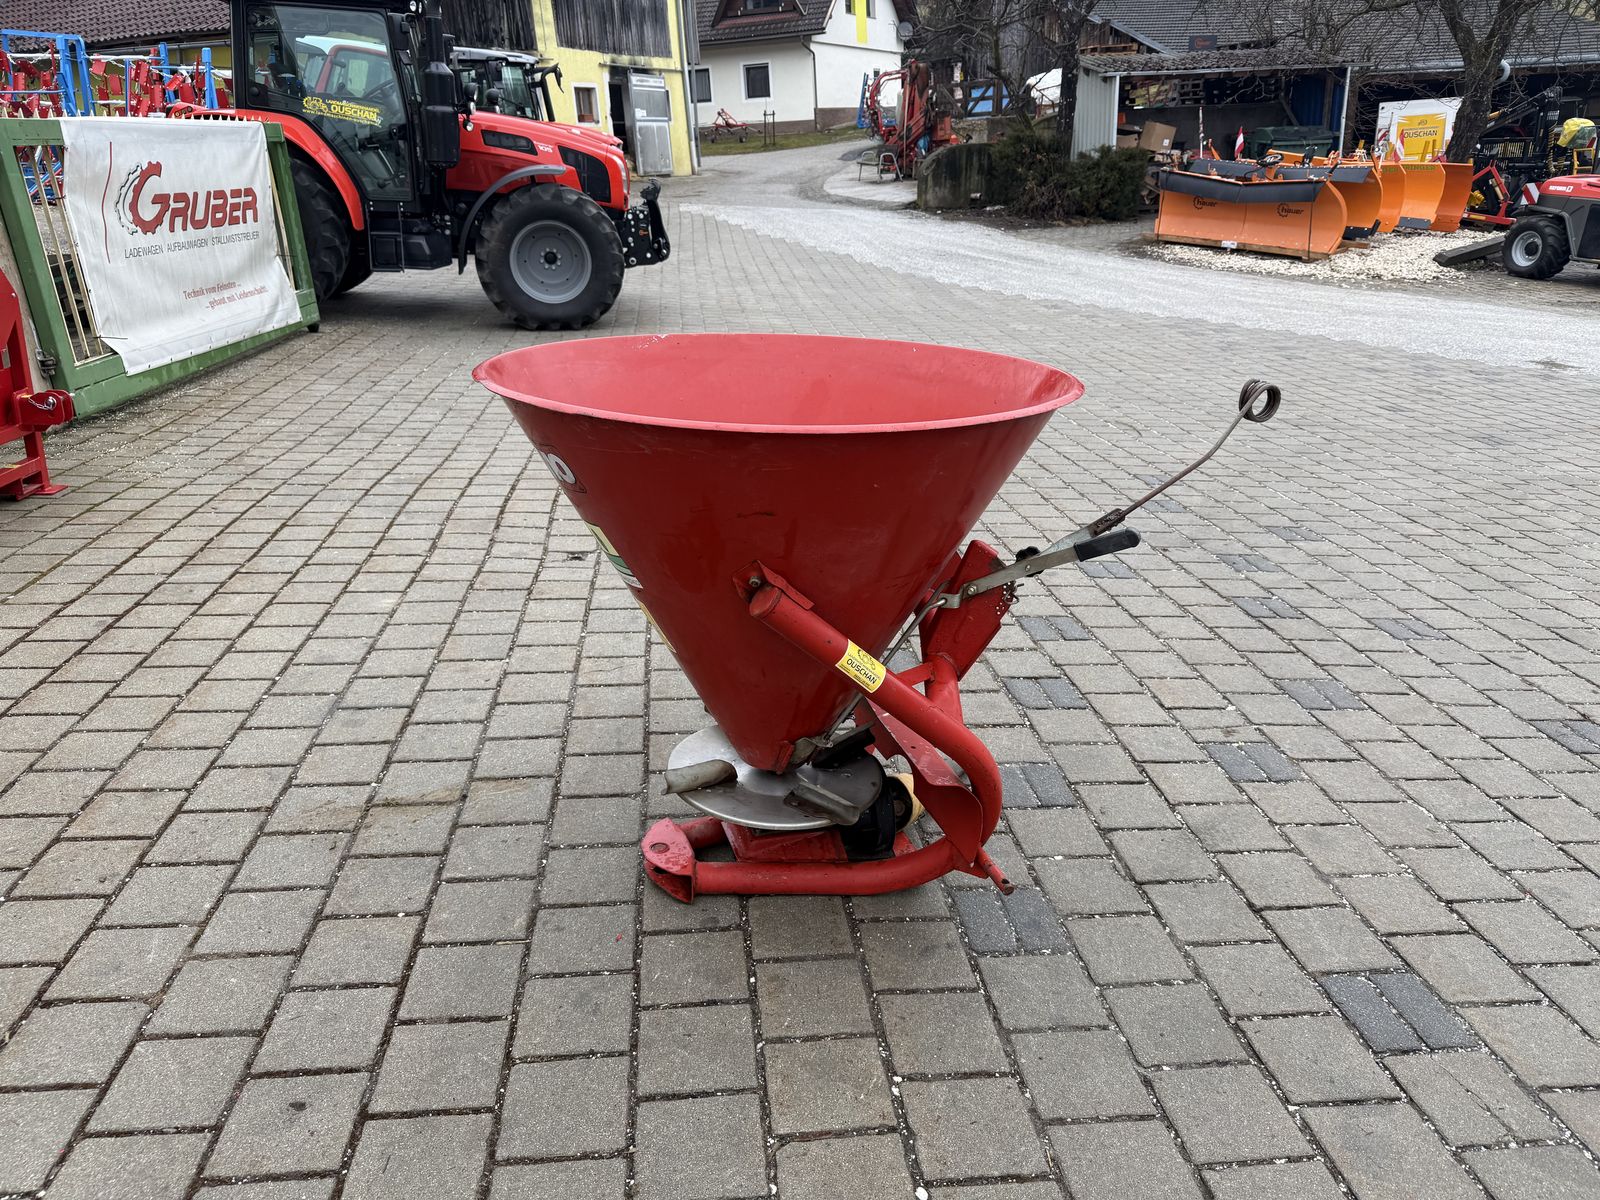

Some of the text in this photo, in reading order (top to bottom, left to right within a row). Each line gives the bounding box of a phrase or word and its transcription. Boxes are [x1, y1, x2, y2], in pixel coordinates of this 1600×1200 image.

[331, 104, 377, 119] OUSCHAN
[1403, 129, 1438, 139] OUSCHAN
[129, 160, 258, 235] GRUBER
[1197, 198, 1218, 208] hauer
[1281, 204, 1304, 215] hauer
[124, 231, 261, 259] LADEWAGEN AUFBAUWAGEN STALLMISTSTREUER
[183, 287, 205, 300] Technik
[846, 658, 878, 685] OUSCHAN
